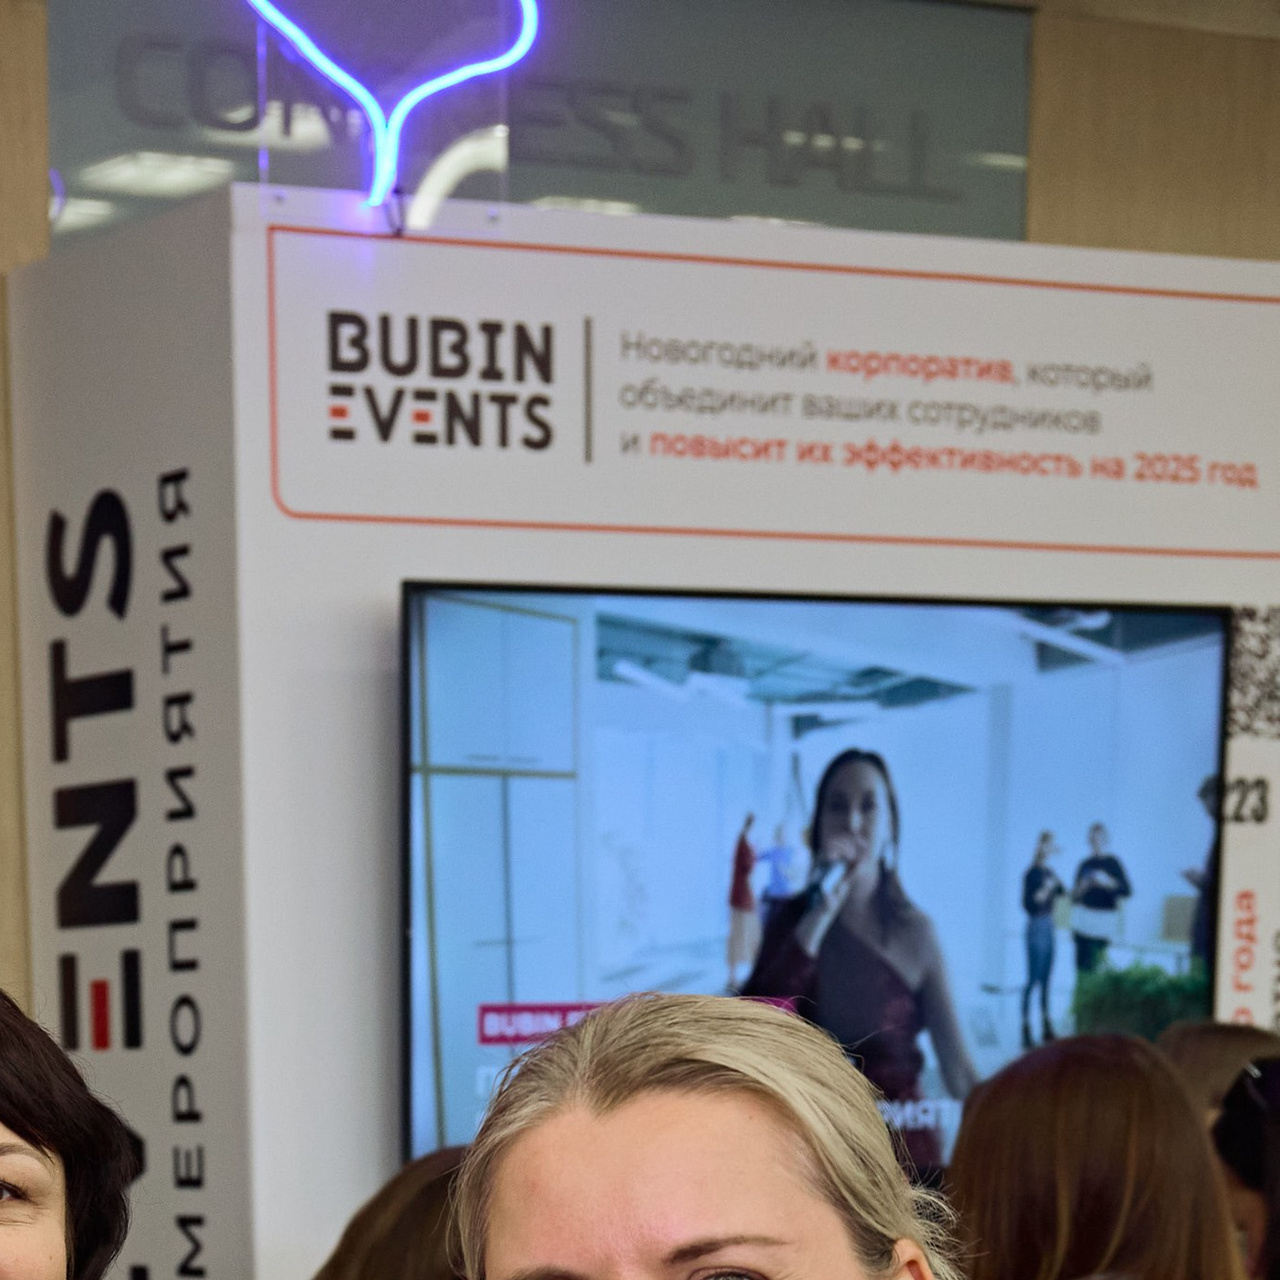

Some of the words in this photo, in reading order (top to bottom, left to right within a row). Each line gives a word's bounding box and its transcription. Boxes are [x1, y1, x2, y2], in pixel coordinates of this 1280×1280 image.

[328, 310, 553, 384] BUBIN
[620, 331, 819, 371] Новогодний
[826, 348, 1021, 385] корпоратив,
[1026, 360, 1154, 394] который
[328, 384, 553, 451] EVENTS
[620, 377, 795, 418] объединит
[804, 394, 899, 424] ваших
[908, 401, 1103, 436] сотрудников
[620, 432, 641, 454] и
[649, 431, 788, 462] повысит
[796, 443, 835, 465] их
[841, 438, 1083, 480] эффективность
[1089, 457, 1127, 482] на
[1132, 451, 1202, 486] 2025
[1207, 458, 1260, 490] год
[157, 467, 208, 1278] МЕРОПРИЯТИЯ
